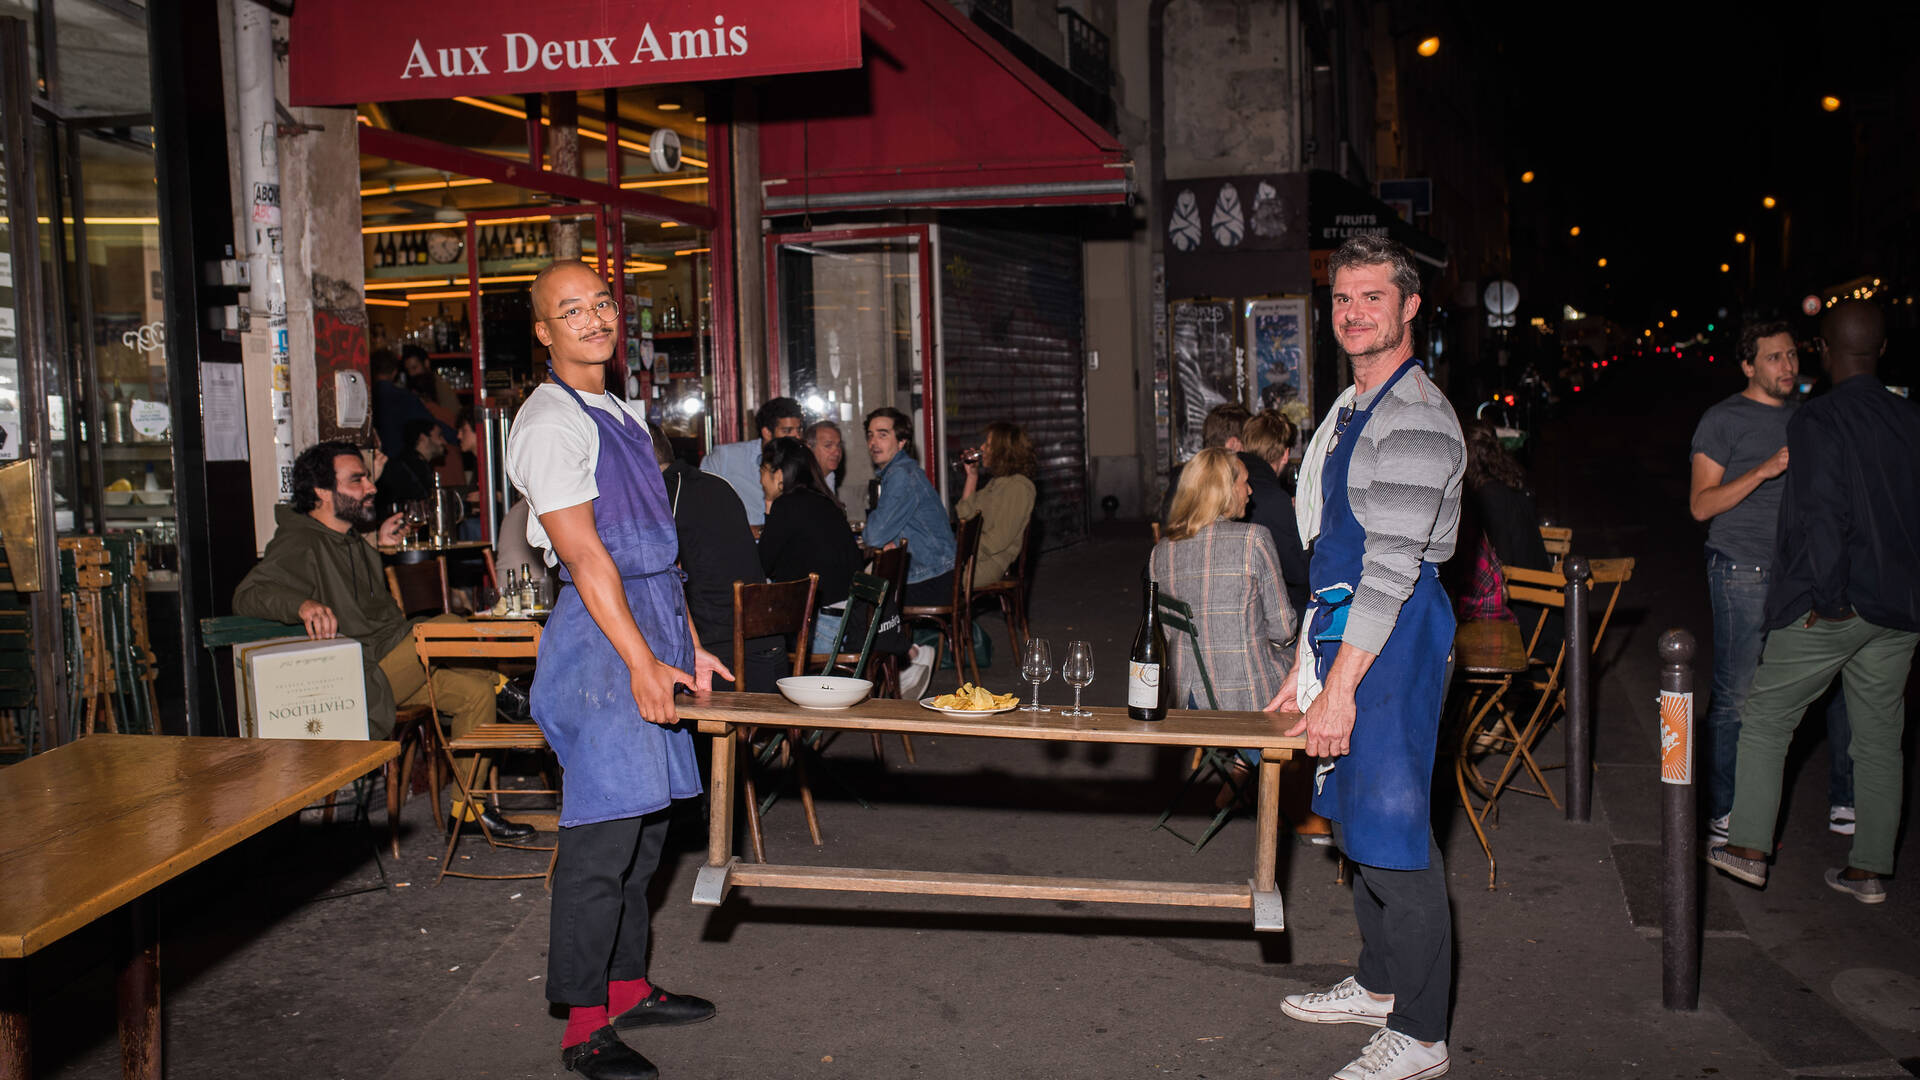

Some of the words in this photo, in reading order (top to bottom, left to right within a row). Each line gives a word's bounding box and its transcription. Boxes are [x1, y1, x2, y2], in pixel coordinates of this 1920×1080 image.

[400, 39, 491, 79] Aux
[502, 32, 620, 74] Deux
[630, 15, 749, 64] Amis
[1335, 214, 1377, 226] FRUITS
[1322, 227, 1338, 239] ET
[268, 698, 355, 720] CHATELDON
